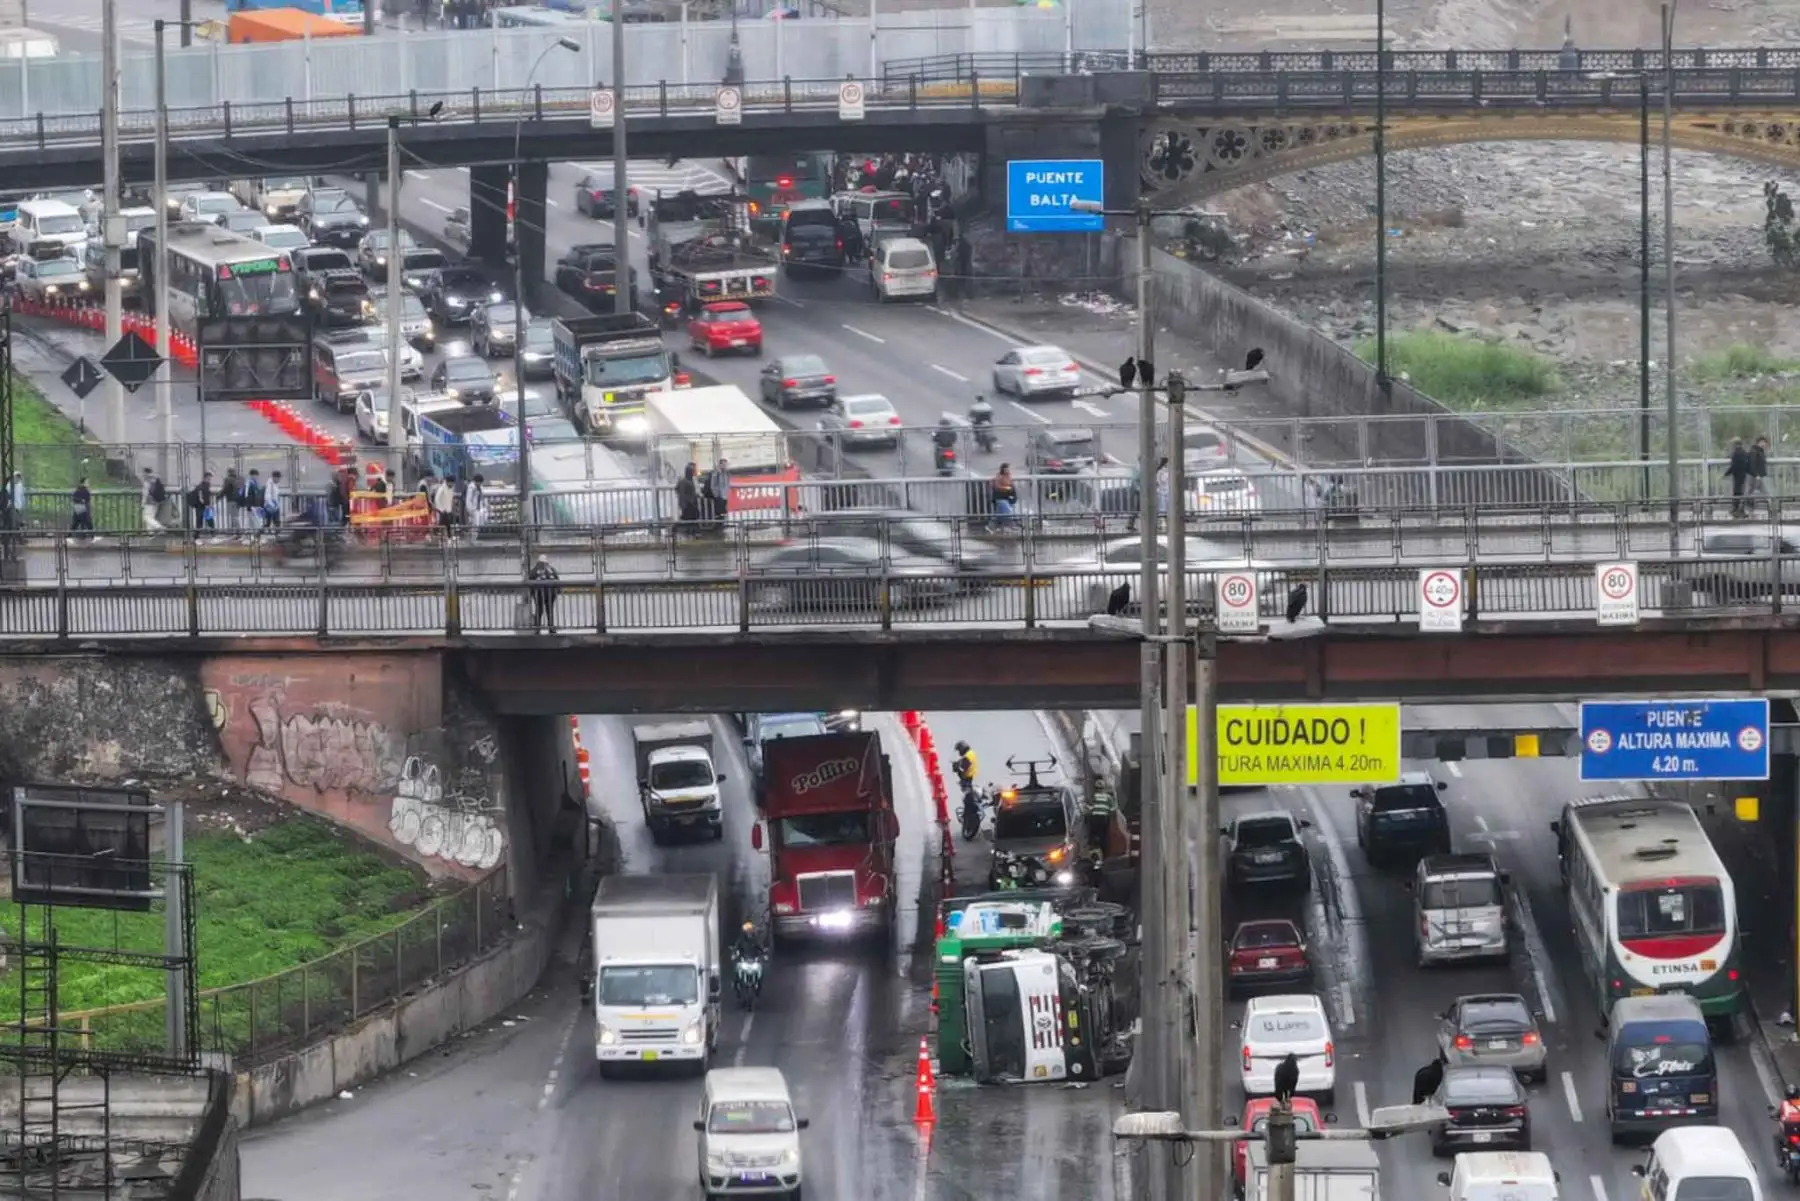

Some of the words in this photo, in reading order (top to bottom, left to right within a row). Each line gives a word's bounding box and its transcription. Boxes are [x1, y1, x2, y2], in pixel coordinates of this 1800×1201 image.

[1026, 171, 1084, 184] PUENTE
[1030, 193, 1079, 206] BALTA
[1608, 573, 1626, 588] 80
[1228, 582, 1246, 596] 80
[1226, 717, 1350, 746] CUIDADO
[1359, 717, 1366, 745] !
[1618, 732, 1673, 750] ALTURA
[1676, 731, 1731, 749] MAXIMA
[1218, 755, 1262, 772] TURA
[1266, 755, 1332, 772] MAXIMA
[1652, 755, 1679, 772] 4.20
[1652, 964, 1698, 975] ETINSA
